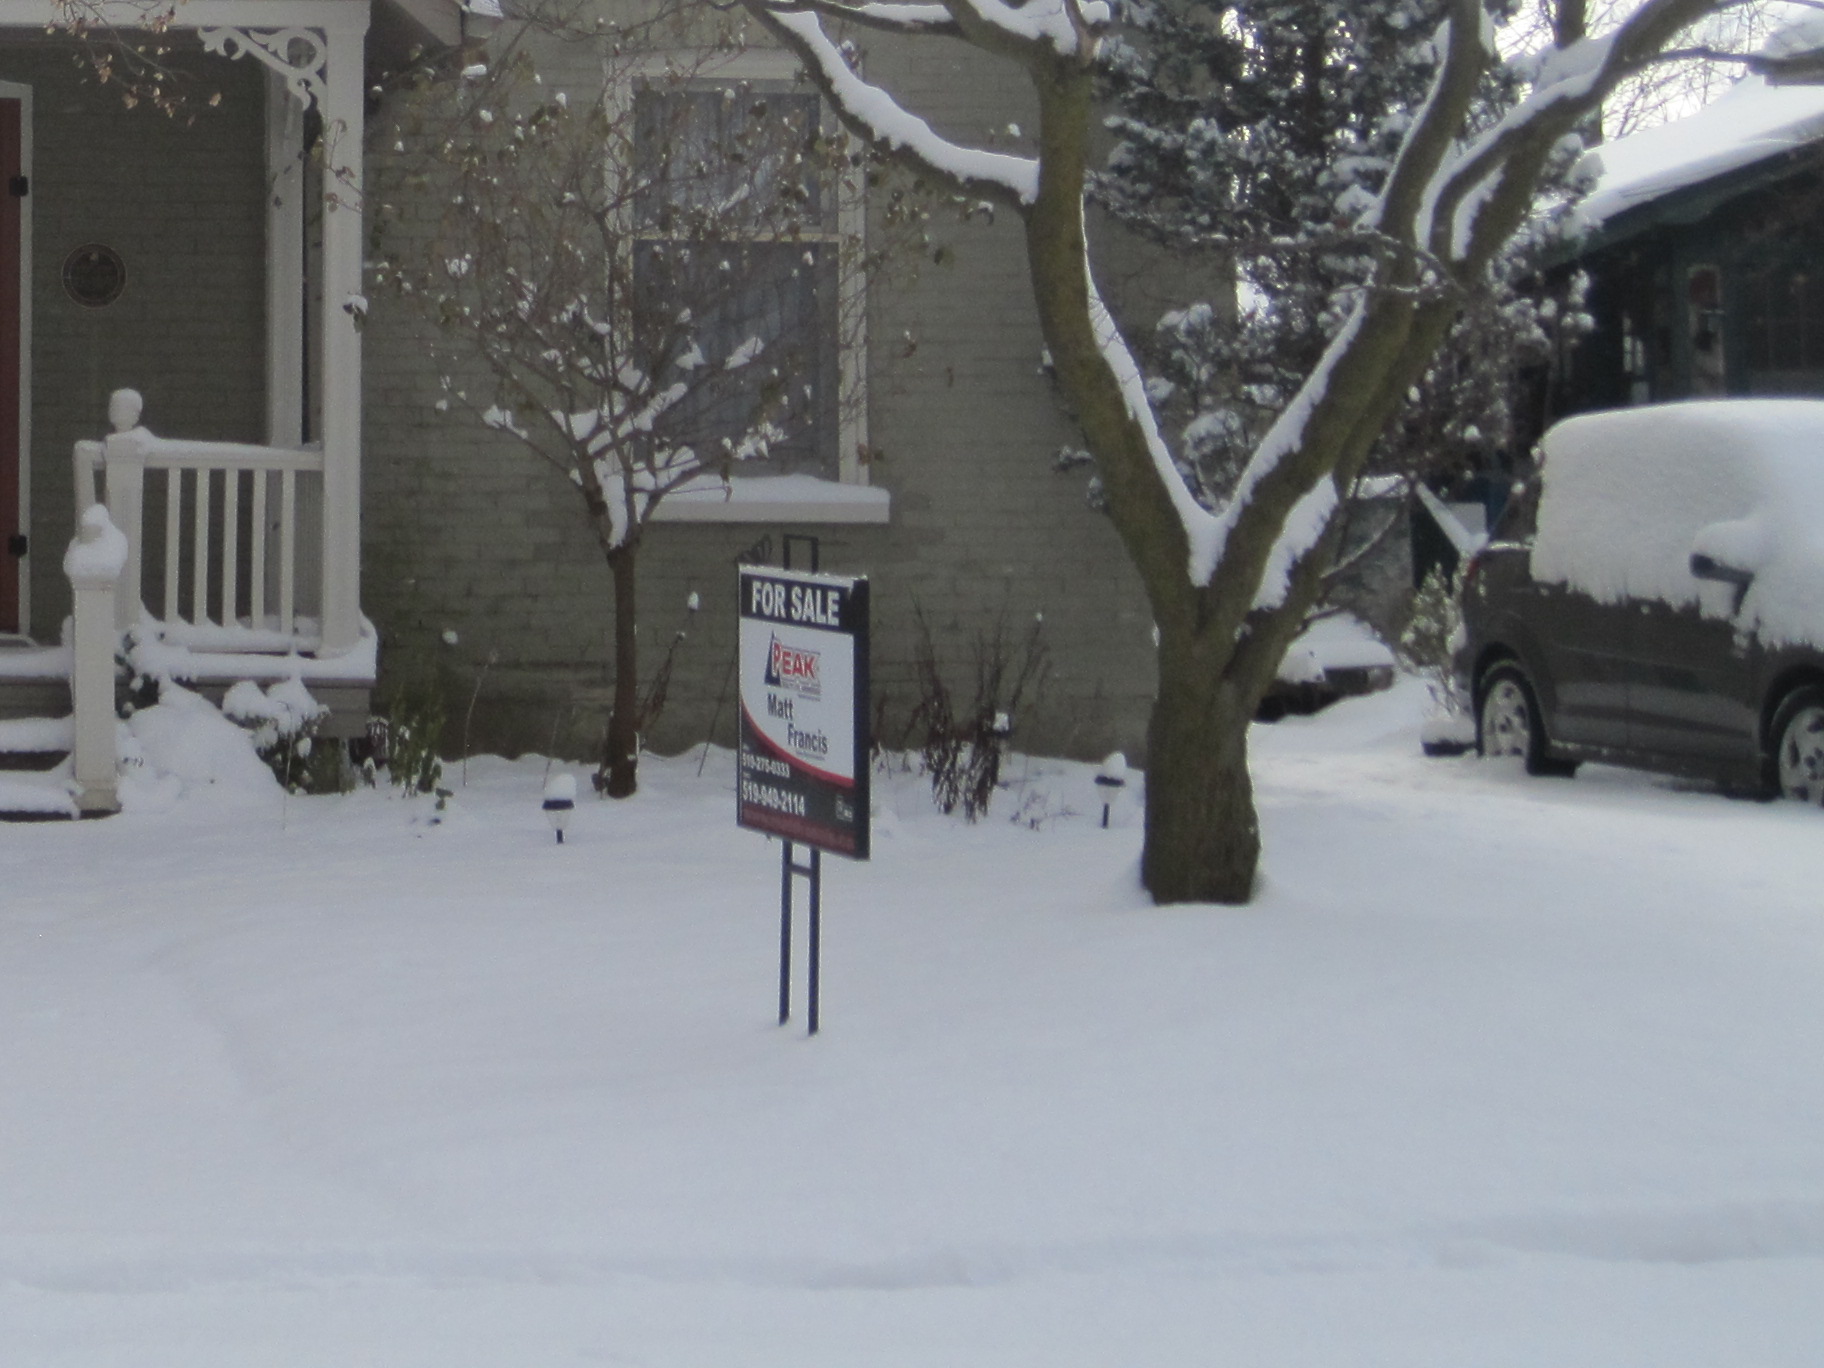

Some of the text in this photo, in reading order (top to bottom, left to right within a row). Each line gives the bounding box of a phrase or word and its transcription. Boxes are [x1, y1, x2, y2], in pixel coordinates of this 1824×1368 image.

[751, 581, 840, 626] FOR SALE
[772, 640, 817, 679] PEAK
[767, 693, 794, 721] Matt
[787, 722, 828, 754] Francis
[742, 779, 805, 817] 519-949-2114
